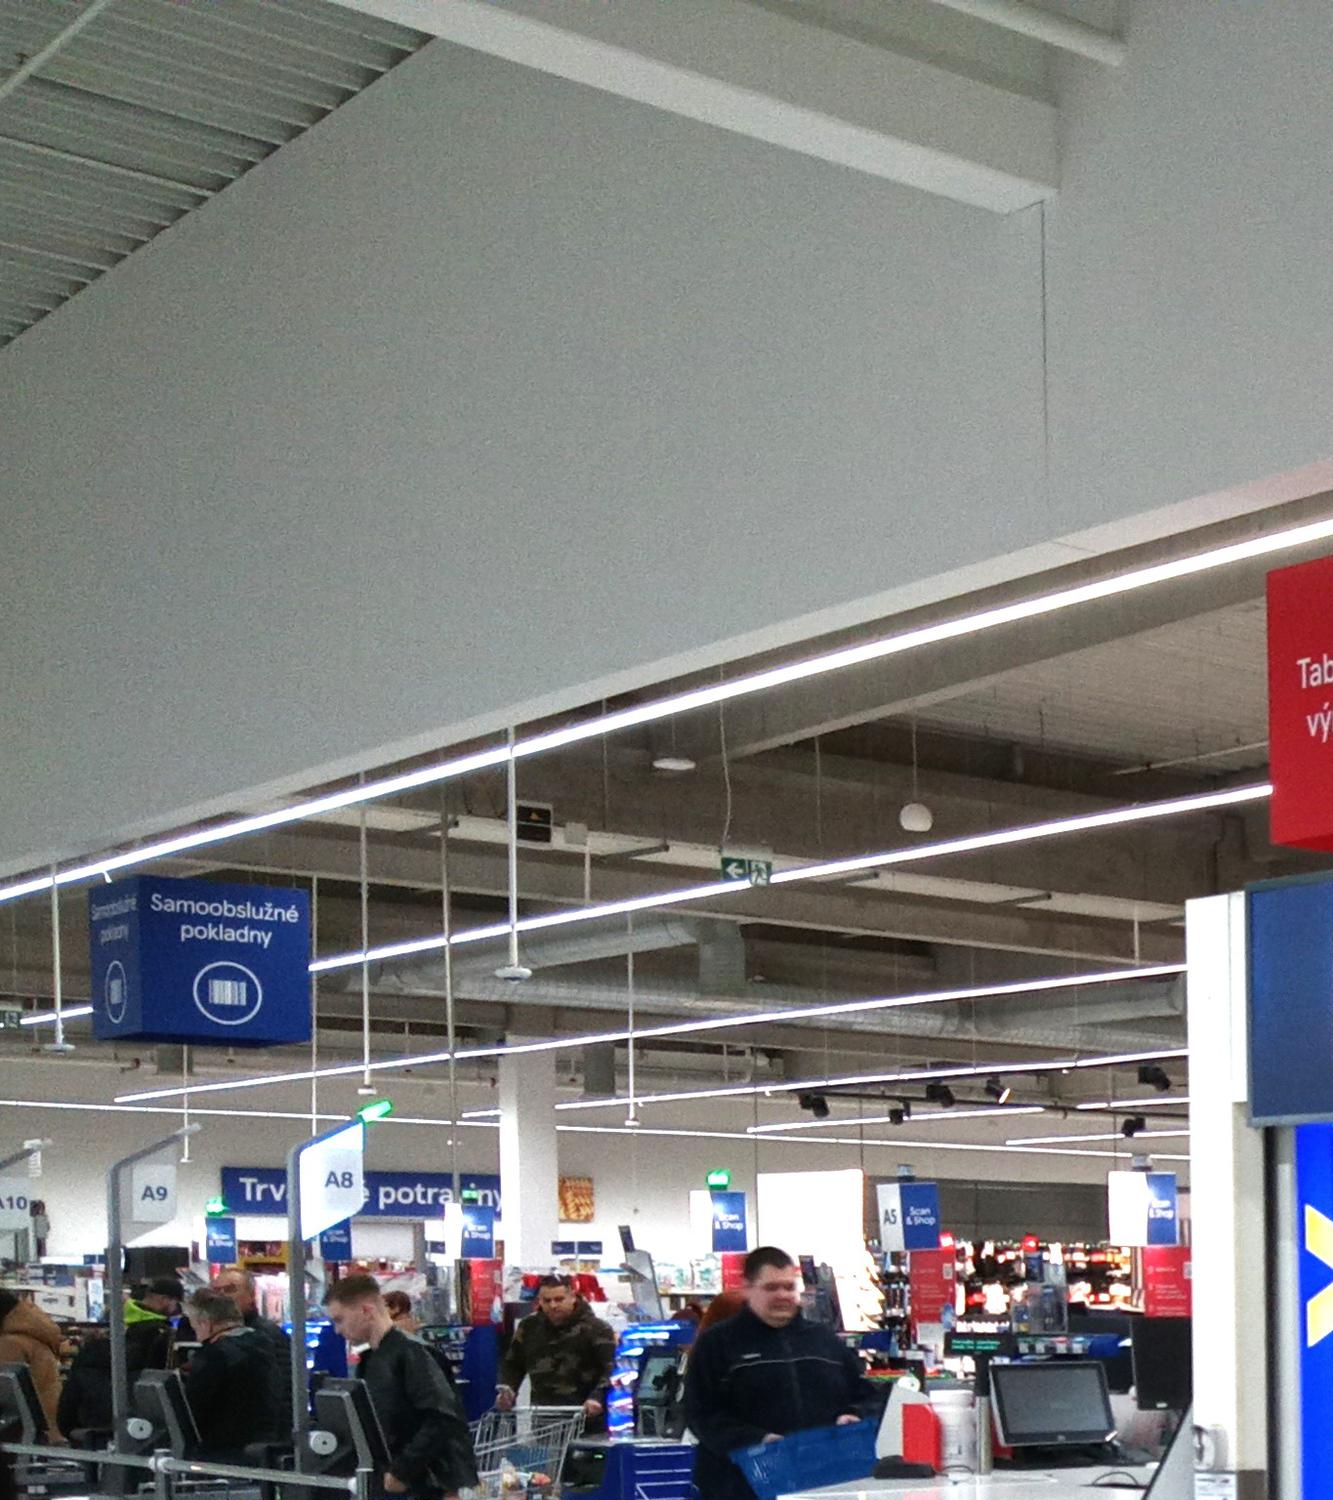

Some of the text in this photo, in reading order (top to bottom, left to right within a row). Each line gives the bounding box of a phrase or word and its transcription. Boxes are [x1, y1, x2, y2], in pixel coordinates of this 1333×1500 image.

[150, 893, 299, 923] Samoobslužné
[181, 923, 272, 948] pokladny
[325, 1171, 353, 1188] A8
[141, 1185, 168, 1201] A9
